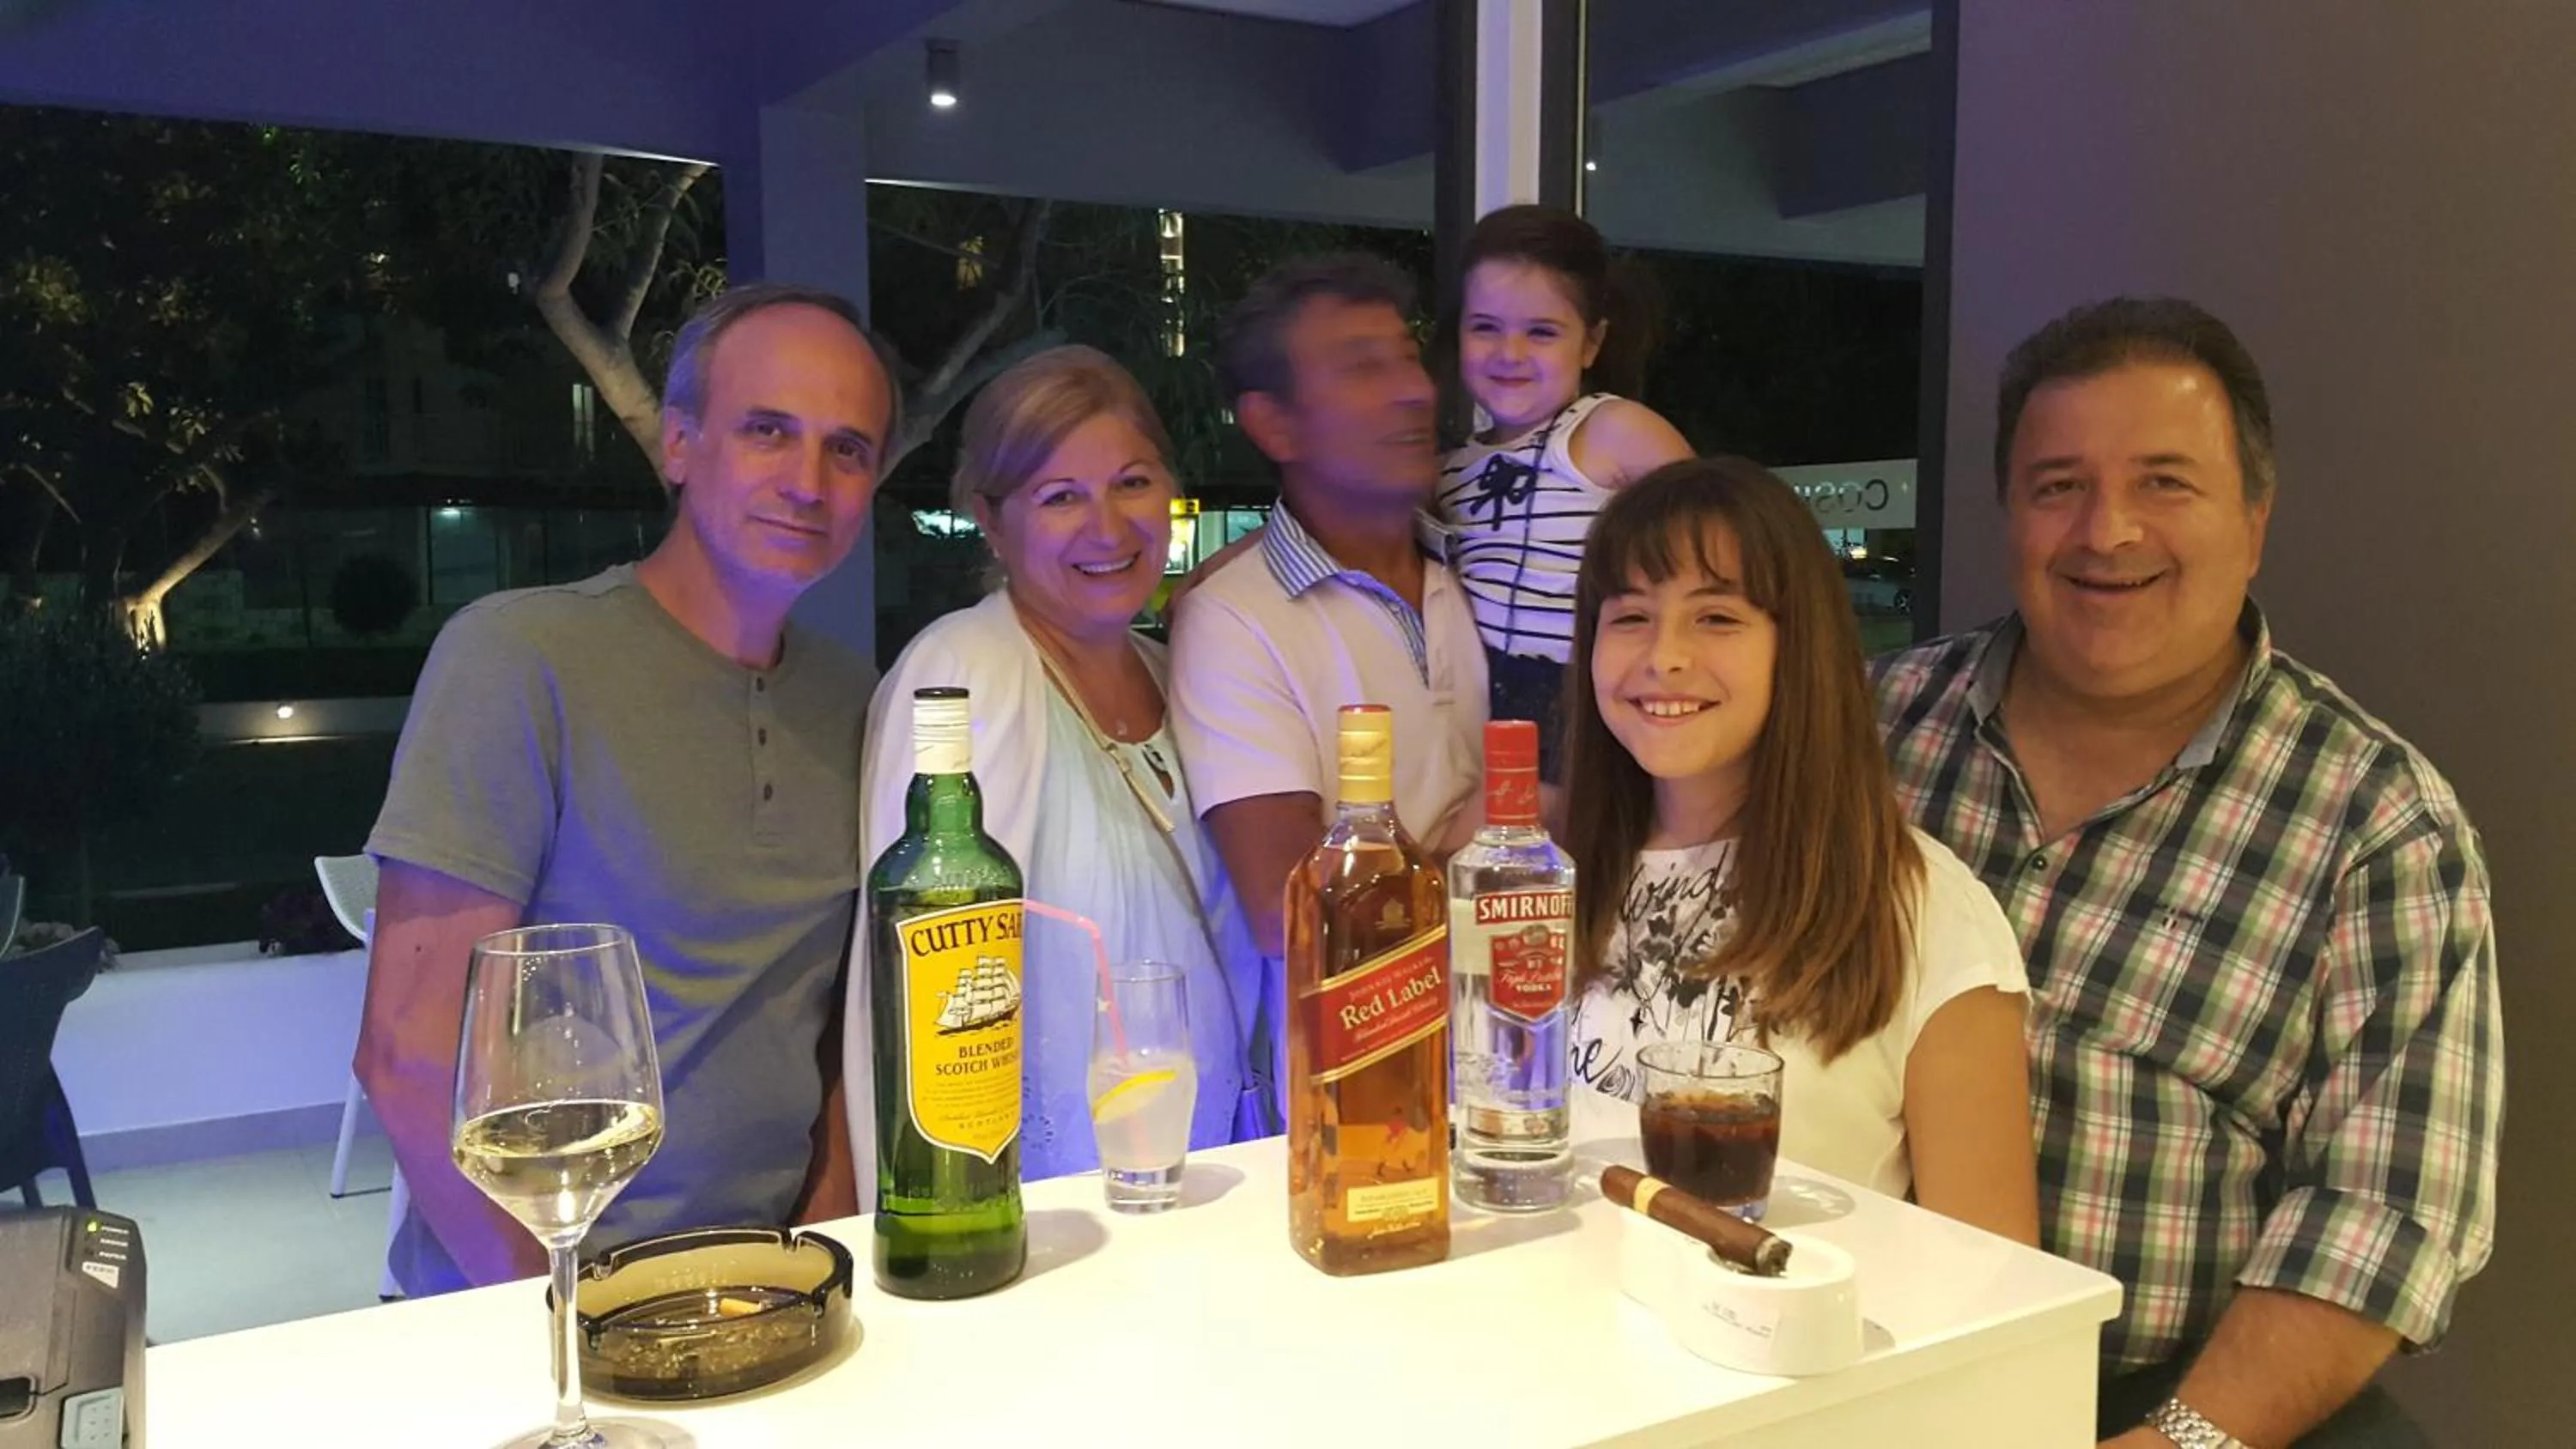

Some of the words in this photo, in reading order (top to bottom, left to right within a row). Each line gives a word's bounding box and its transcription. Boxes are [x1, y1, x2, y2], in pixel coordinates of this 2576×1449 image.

[911, 915, 993, 957] CUTTY
[996, 912, 1022, 940] SA
[1340, 995, 1385, 1030] Red
[1387, 965, 1442, 1009] Label
[936, 1058, 988, 1076] SCOTCH
